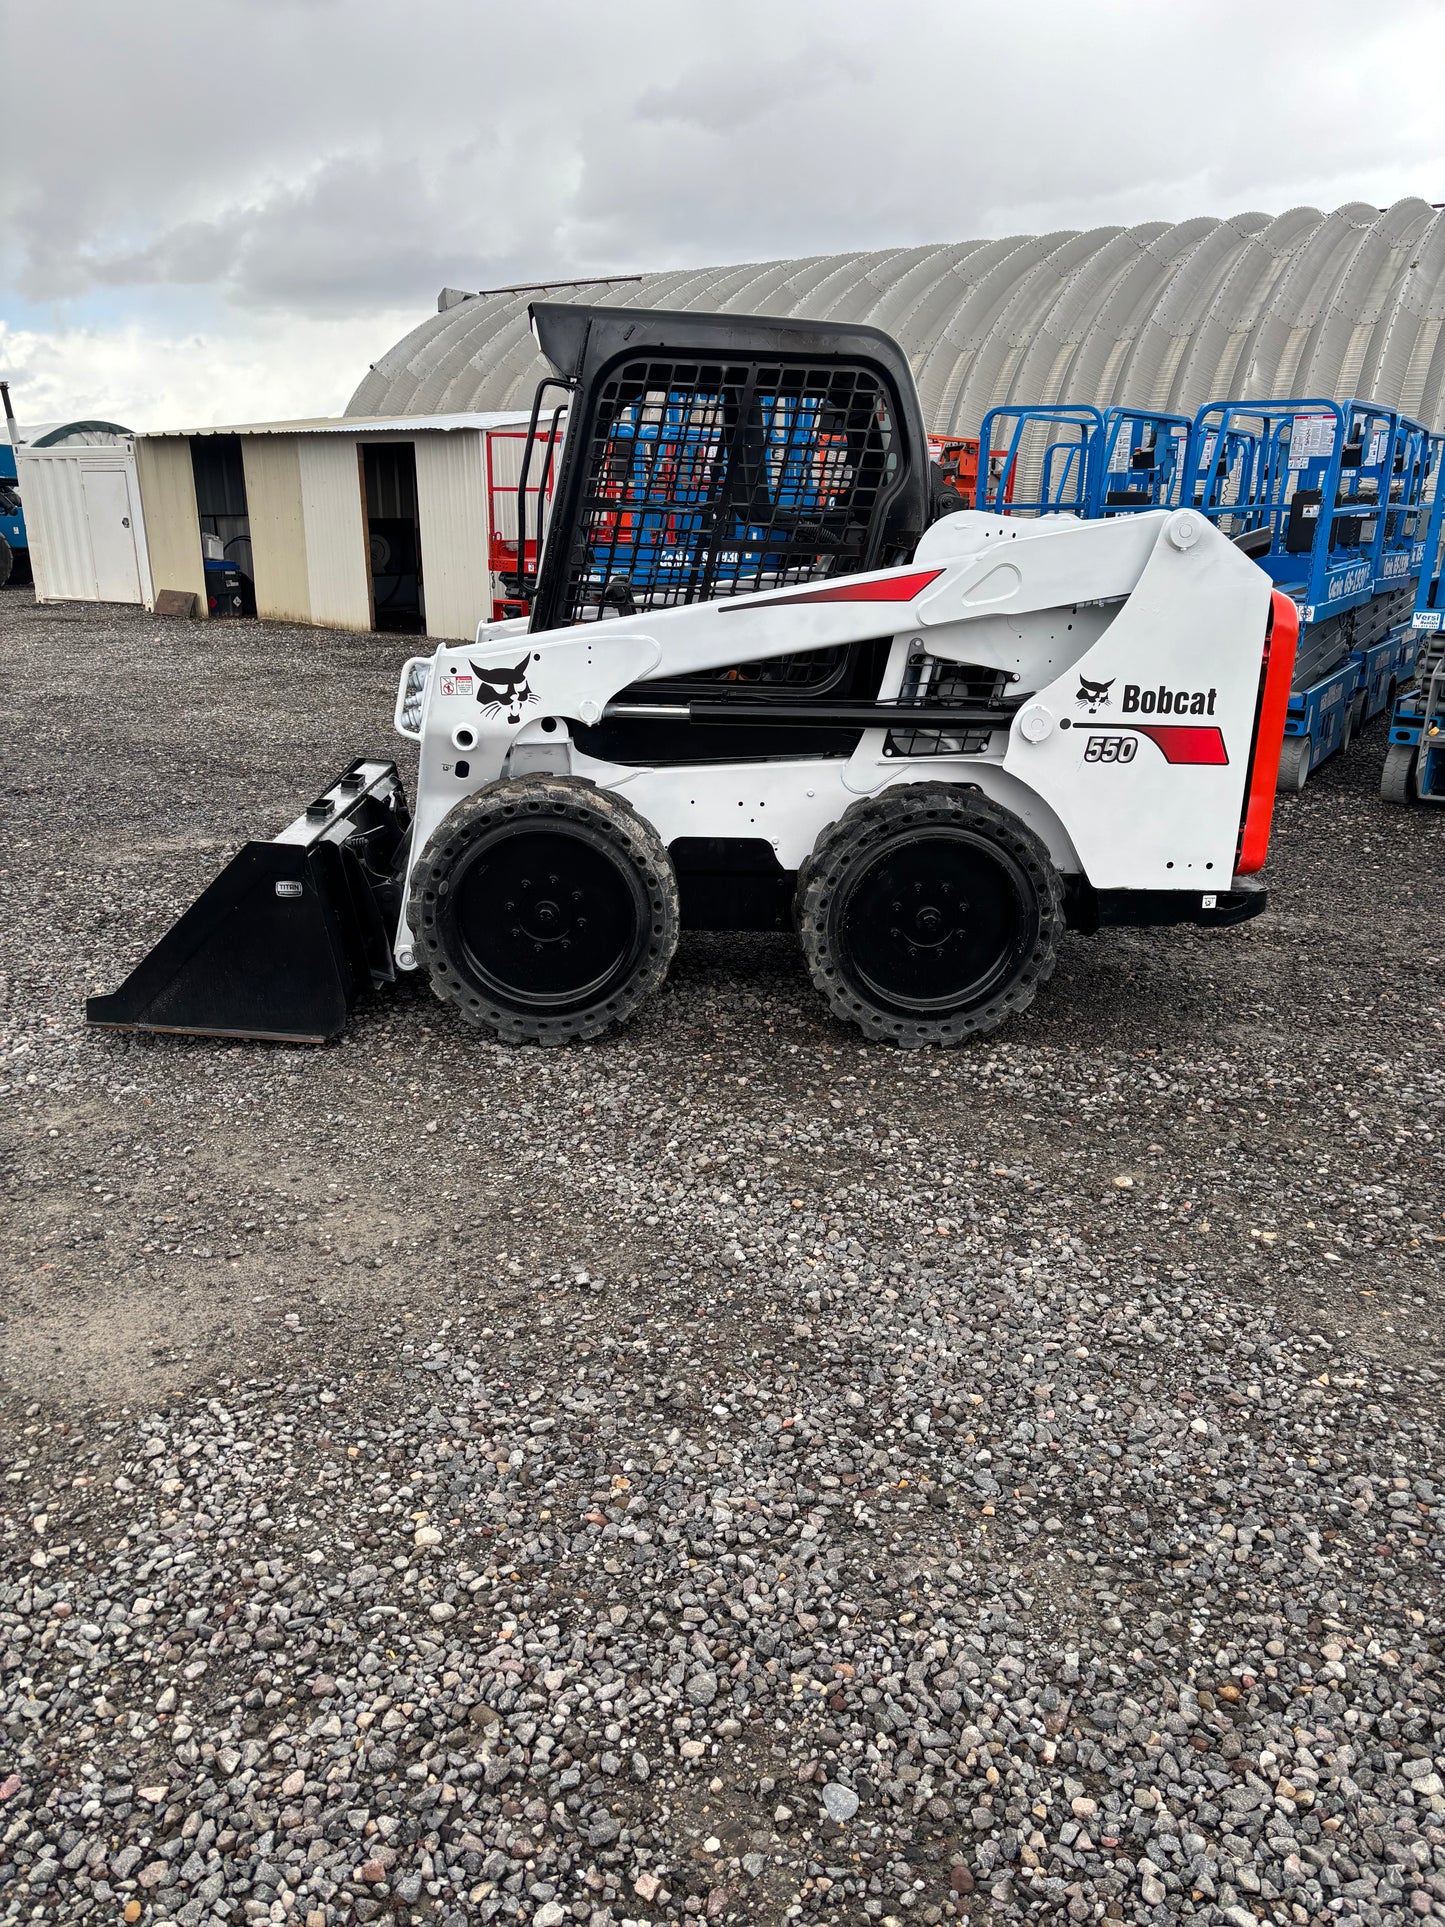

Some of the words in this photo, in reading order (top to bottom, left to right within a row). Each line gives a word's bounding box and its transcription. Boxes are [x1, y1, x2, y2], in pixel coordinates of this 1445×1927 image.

[1328, 576, 1344, 600] Genie
[1415, 613, 1440, 621] Versi
[1122, 685, 1217, 715] Bobcat
[1084, 736, 1139, 763] 550
